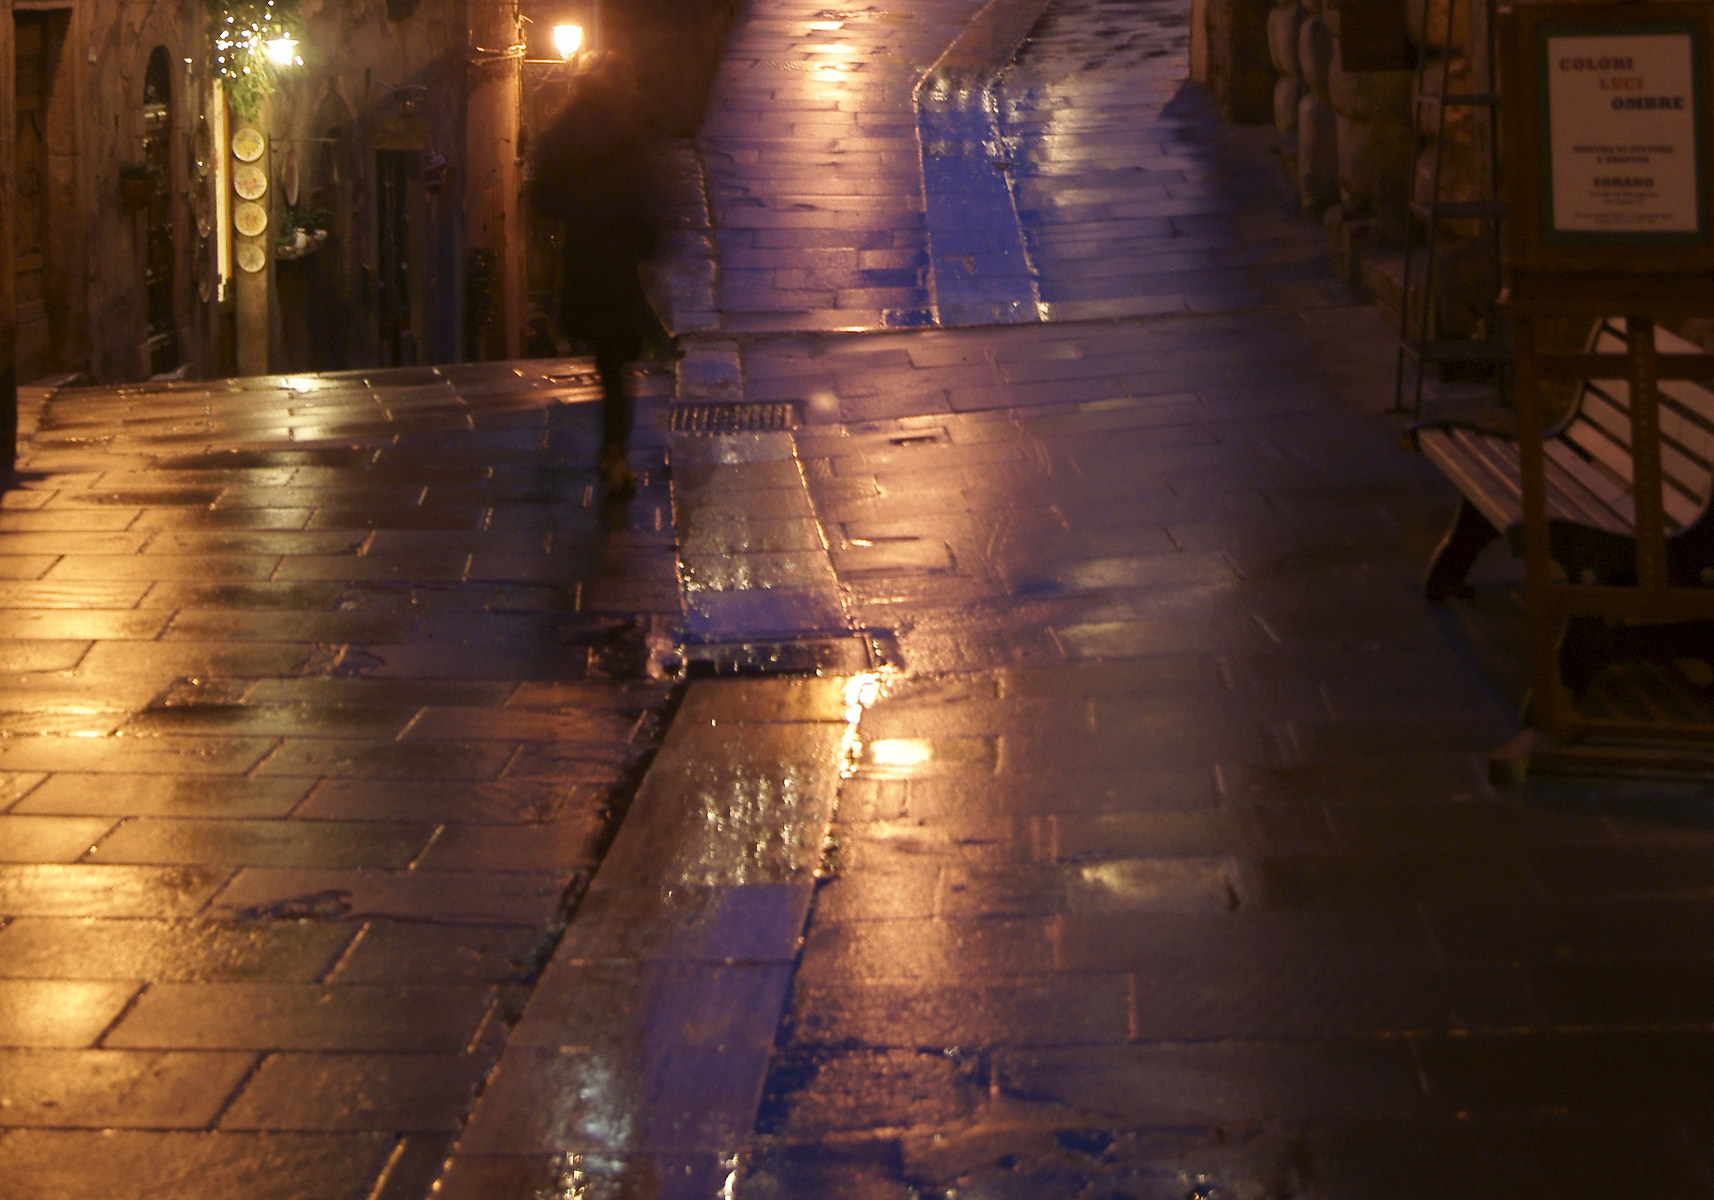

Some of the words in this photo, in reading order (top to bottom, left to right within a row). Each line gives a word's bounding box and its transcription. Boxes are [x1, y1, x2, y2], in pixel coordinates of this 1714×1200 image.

[1559, 58, 1633, 71] COLORI
[1600, 77, 1643, 90] LUCI
[1611, 97, 1684, 110] OMBRE
[1594, 178, 1654, 187] SORANO
